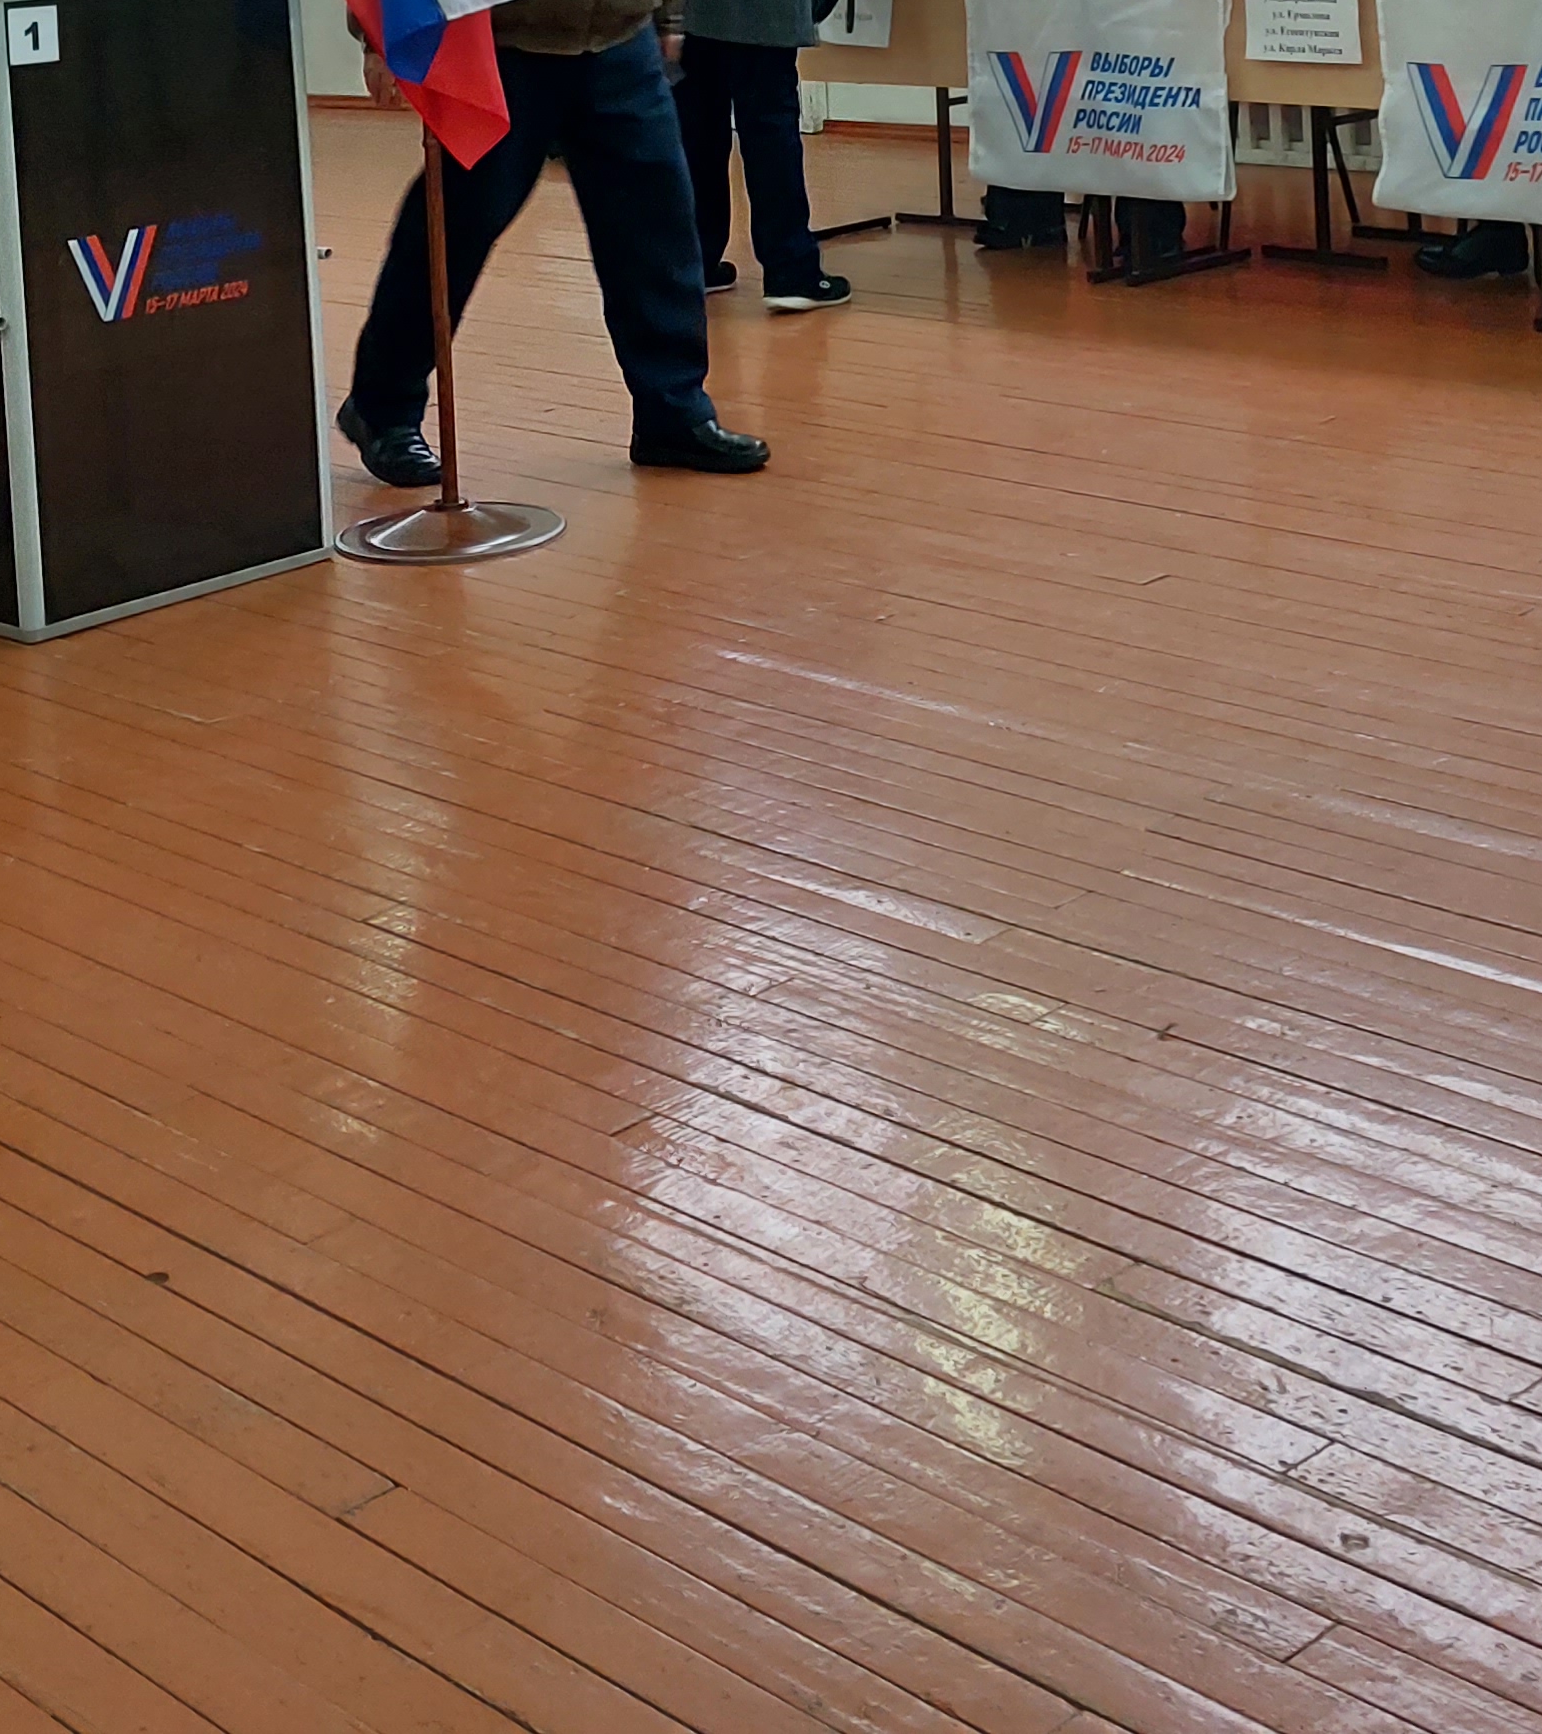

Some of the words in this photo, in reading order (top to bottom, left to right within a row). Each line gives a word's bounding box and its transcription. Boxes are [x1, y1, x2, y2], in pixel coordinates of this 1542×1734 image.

[24, 21, 40, 51] 1
[1090, 52, 1175, 78] ВЫБОРЫ
[1080, 80, 1202, 110] ПРЕЗИДЕНТА
[1072, 109, 1143, 135] РОССИИ
[1103, 139, 1144, 162] МАРТА
[1146, 145, 1186, 163] 2024
